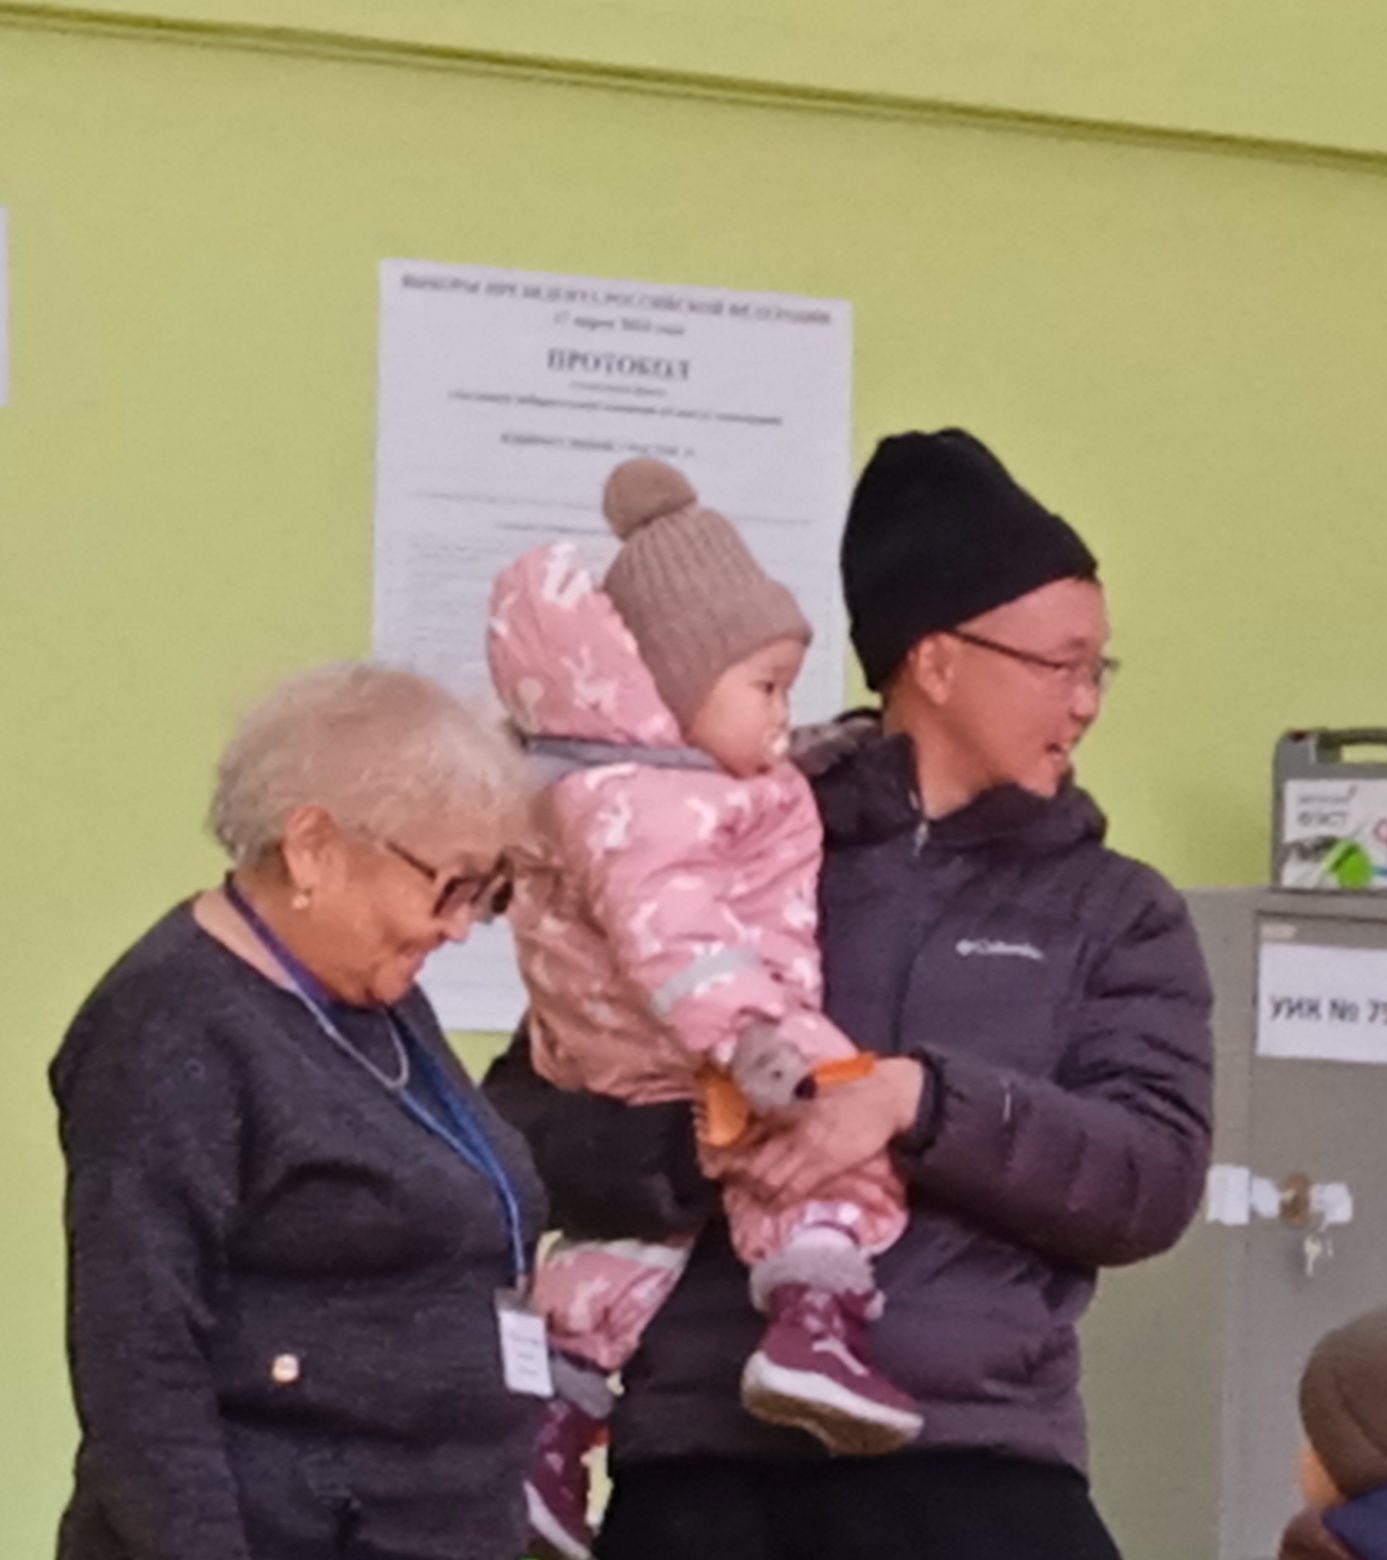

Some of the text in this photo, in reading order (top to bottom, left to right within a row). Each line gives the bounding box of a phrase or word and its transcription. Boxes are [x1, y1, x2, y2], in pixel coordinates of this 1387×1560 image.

[547, 348, 690, 381] ПРОТОКОЛ
[1269, 995, 1322, 1021] УИК
[1328, 998, 1360, 1024] №
